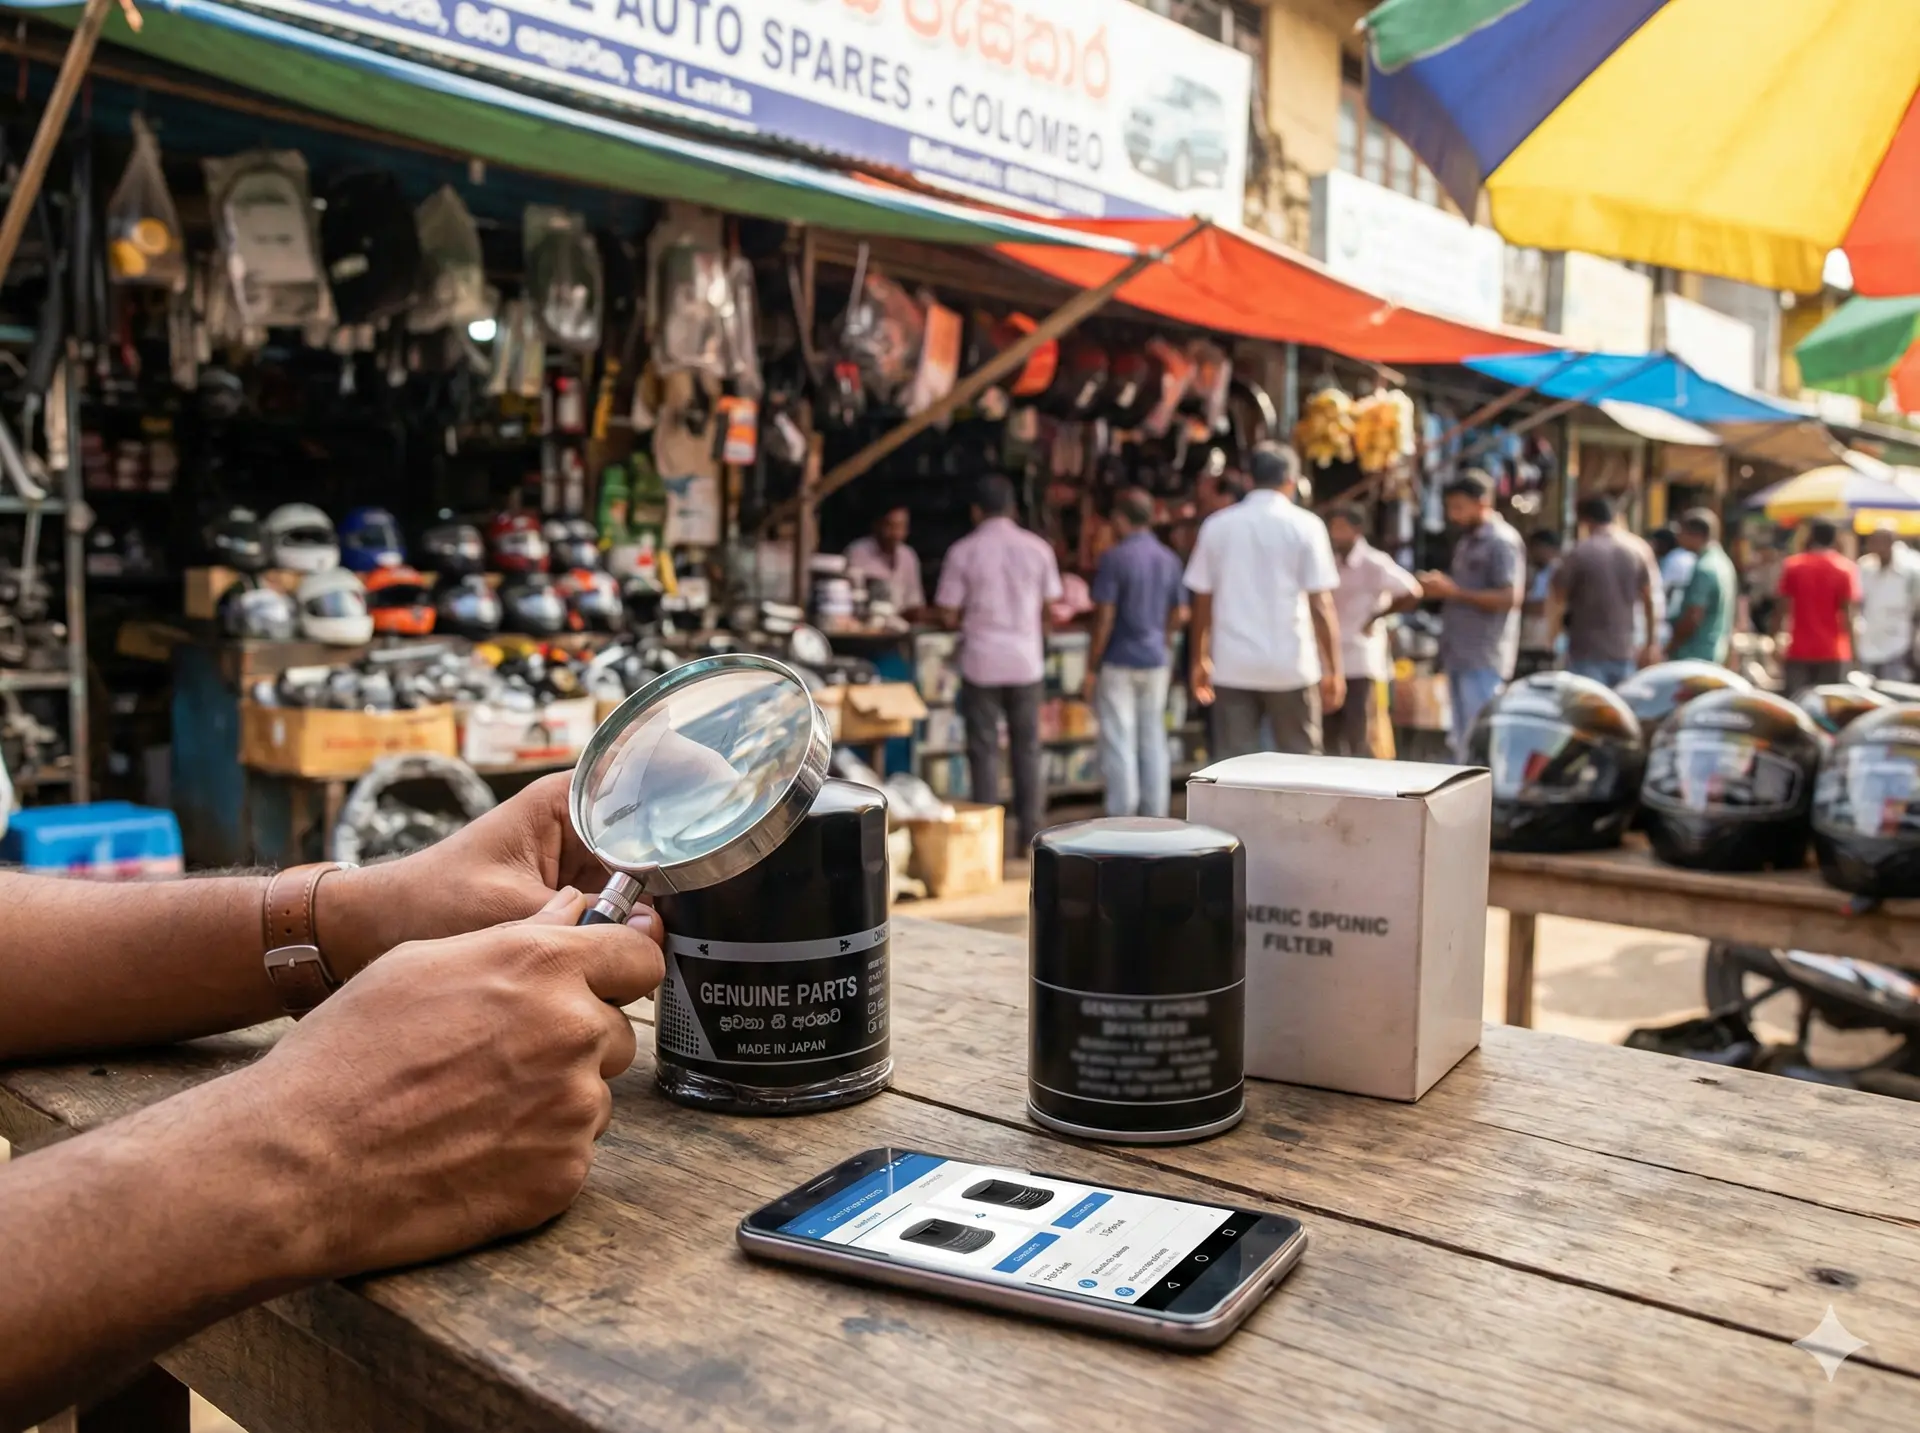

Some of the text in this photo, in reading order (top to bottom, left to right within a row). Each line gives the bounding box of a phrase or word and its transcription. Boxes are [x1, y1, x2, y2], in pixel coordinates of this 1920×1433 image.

[616, 0, 743, 57] AUTO
[762, 18, 912, 111] SPARES
[949, 84, 1103, 172] COLOMBO
[1263, 931, 1334, 957] FILTER
[700, 982, 790, 1007] GENUINE
[797, 975, 858, 1005] PARTS
[737, 1039, 826, 1055] MADE IN JAPAN
